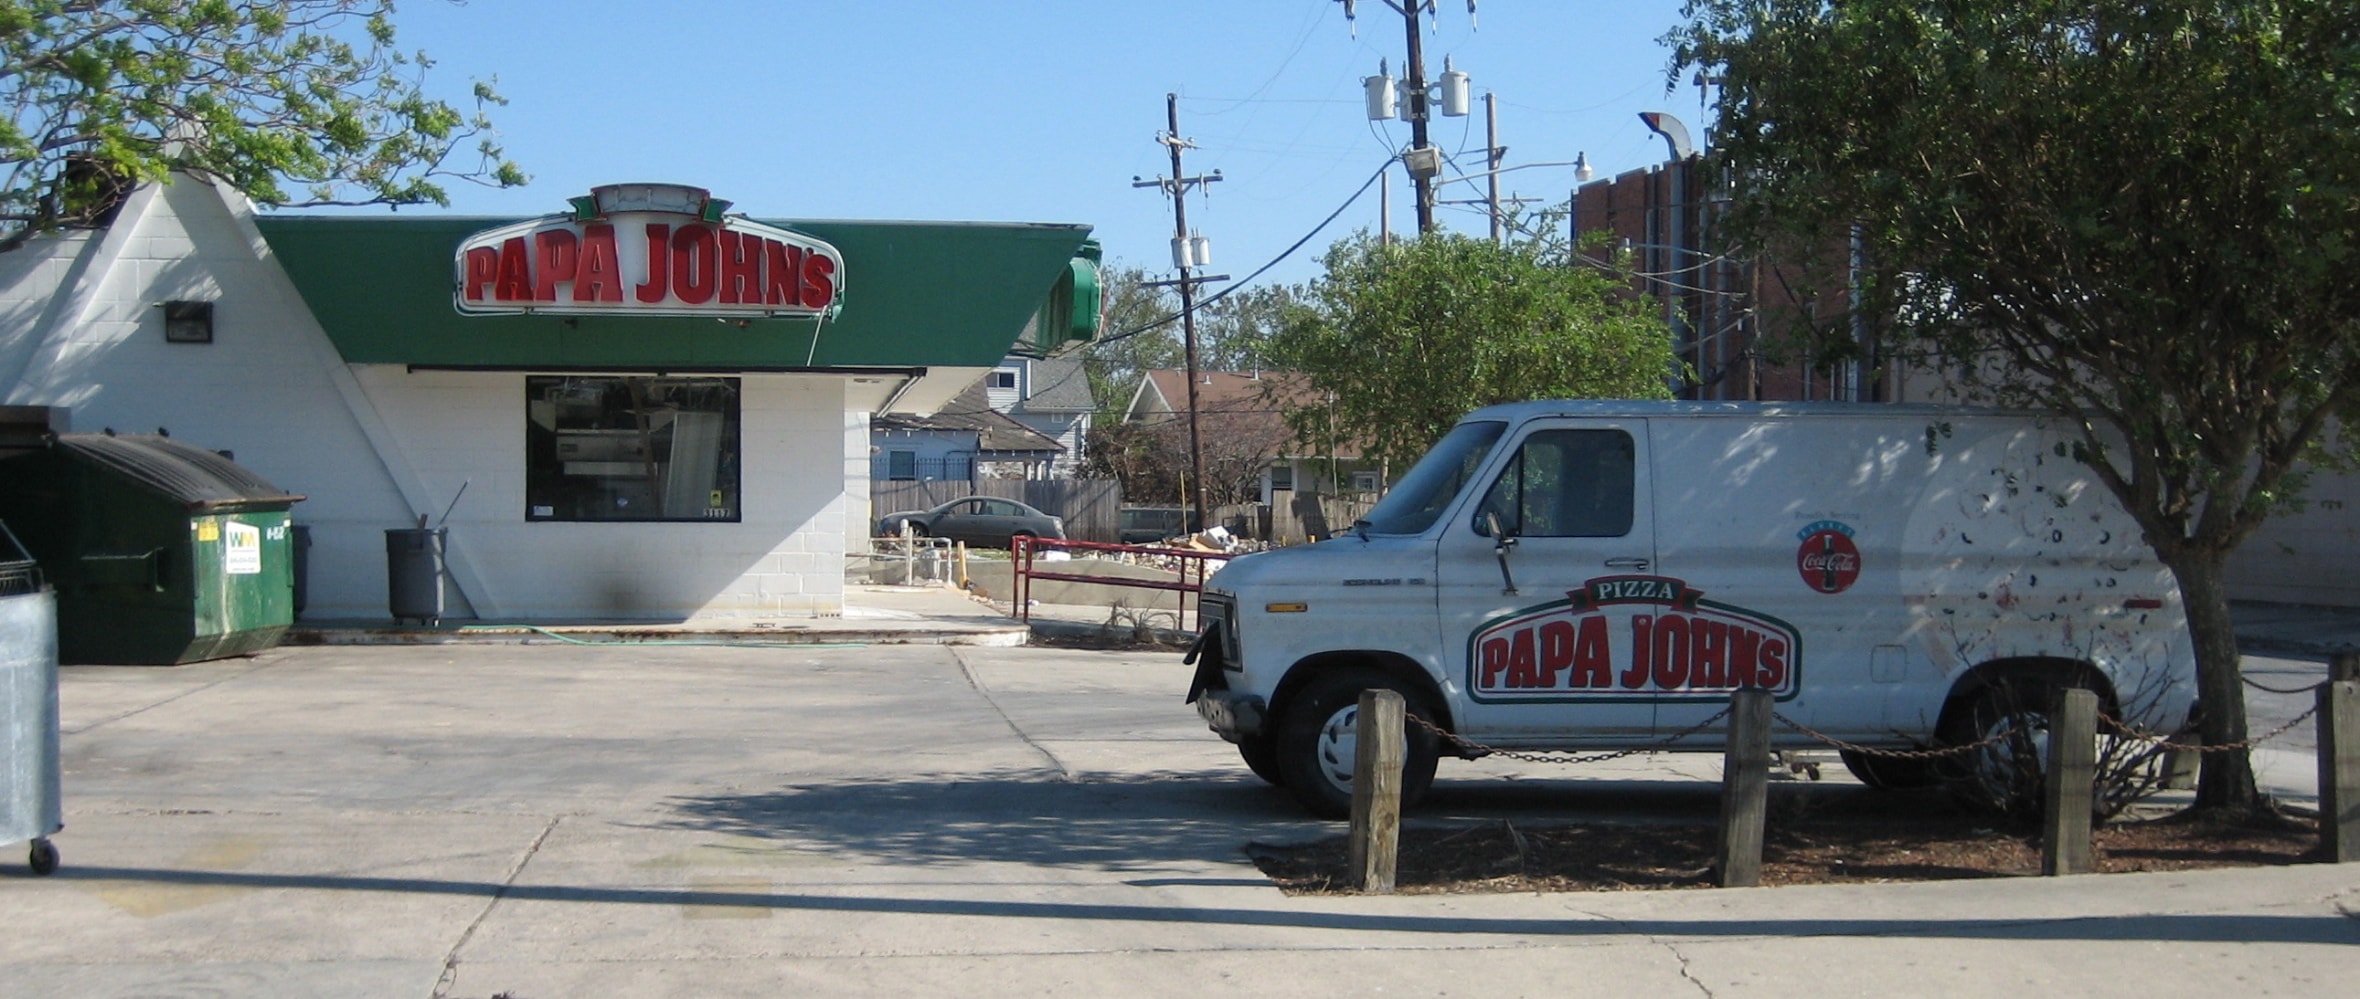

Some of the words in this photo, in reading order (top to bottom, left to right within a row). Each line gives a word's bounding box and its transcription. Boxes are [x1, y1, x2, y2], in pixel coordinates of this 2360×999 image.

[466, 224, 623, 303] PAPA
[229, 531, 255, 547] WM
[1598, 580, 1674, 600] PIZZA
[1481, 615, 1612, 689] PAPA
